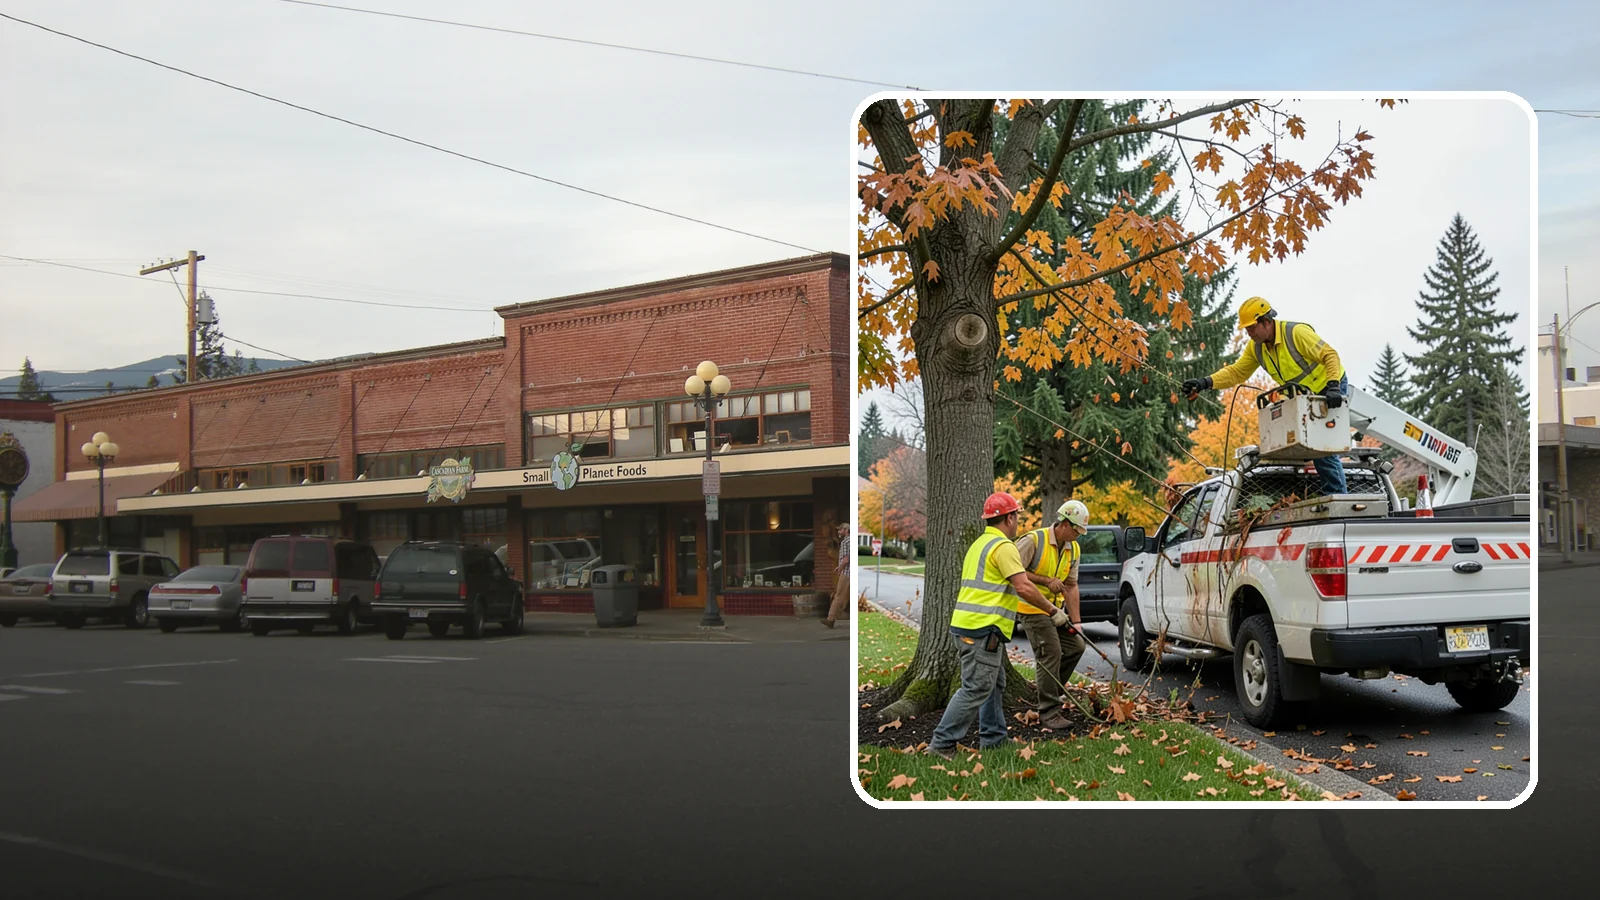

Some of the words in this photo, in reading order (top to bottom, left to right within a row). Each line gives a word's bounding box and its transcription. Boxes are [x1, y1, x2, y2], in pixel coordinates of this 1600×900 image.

[523, 471, 549, 483] Small
[583, 467, 614, 480] Planet
[617, 464, 647, 477] Foods
